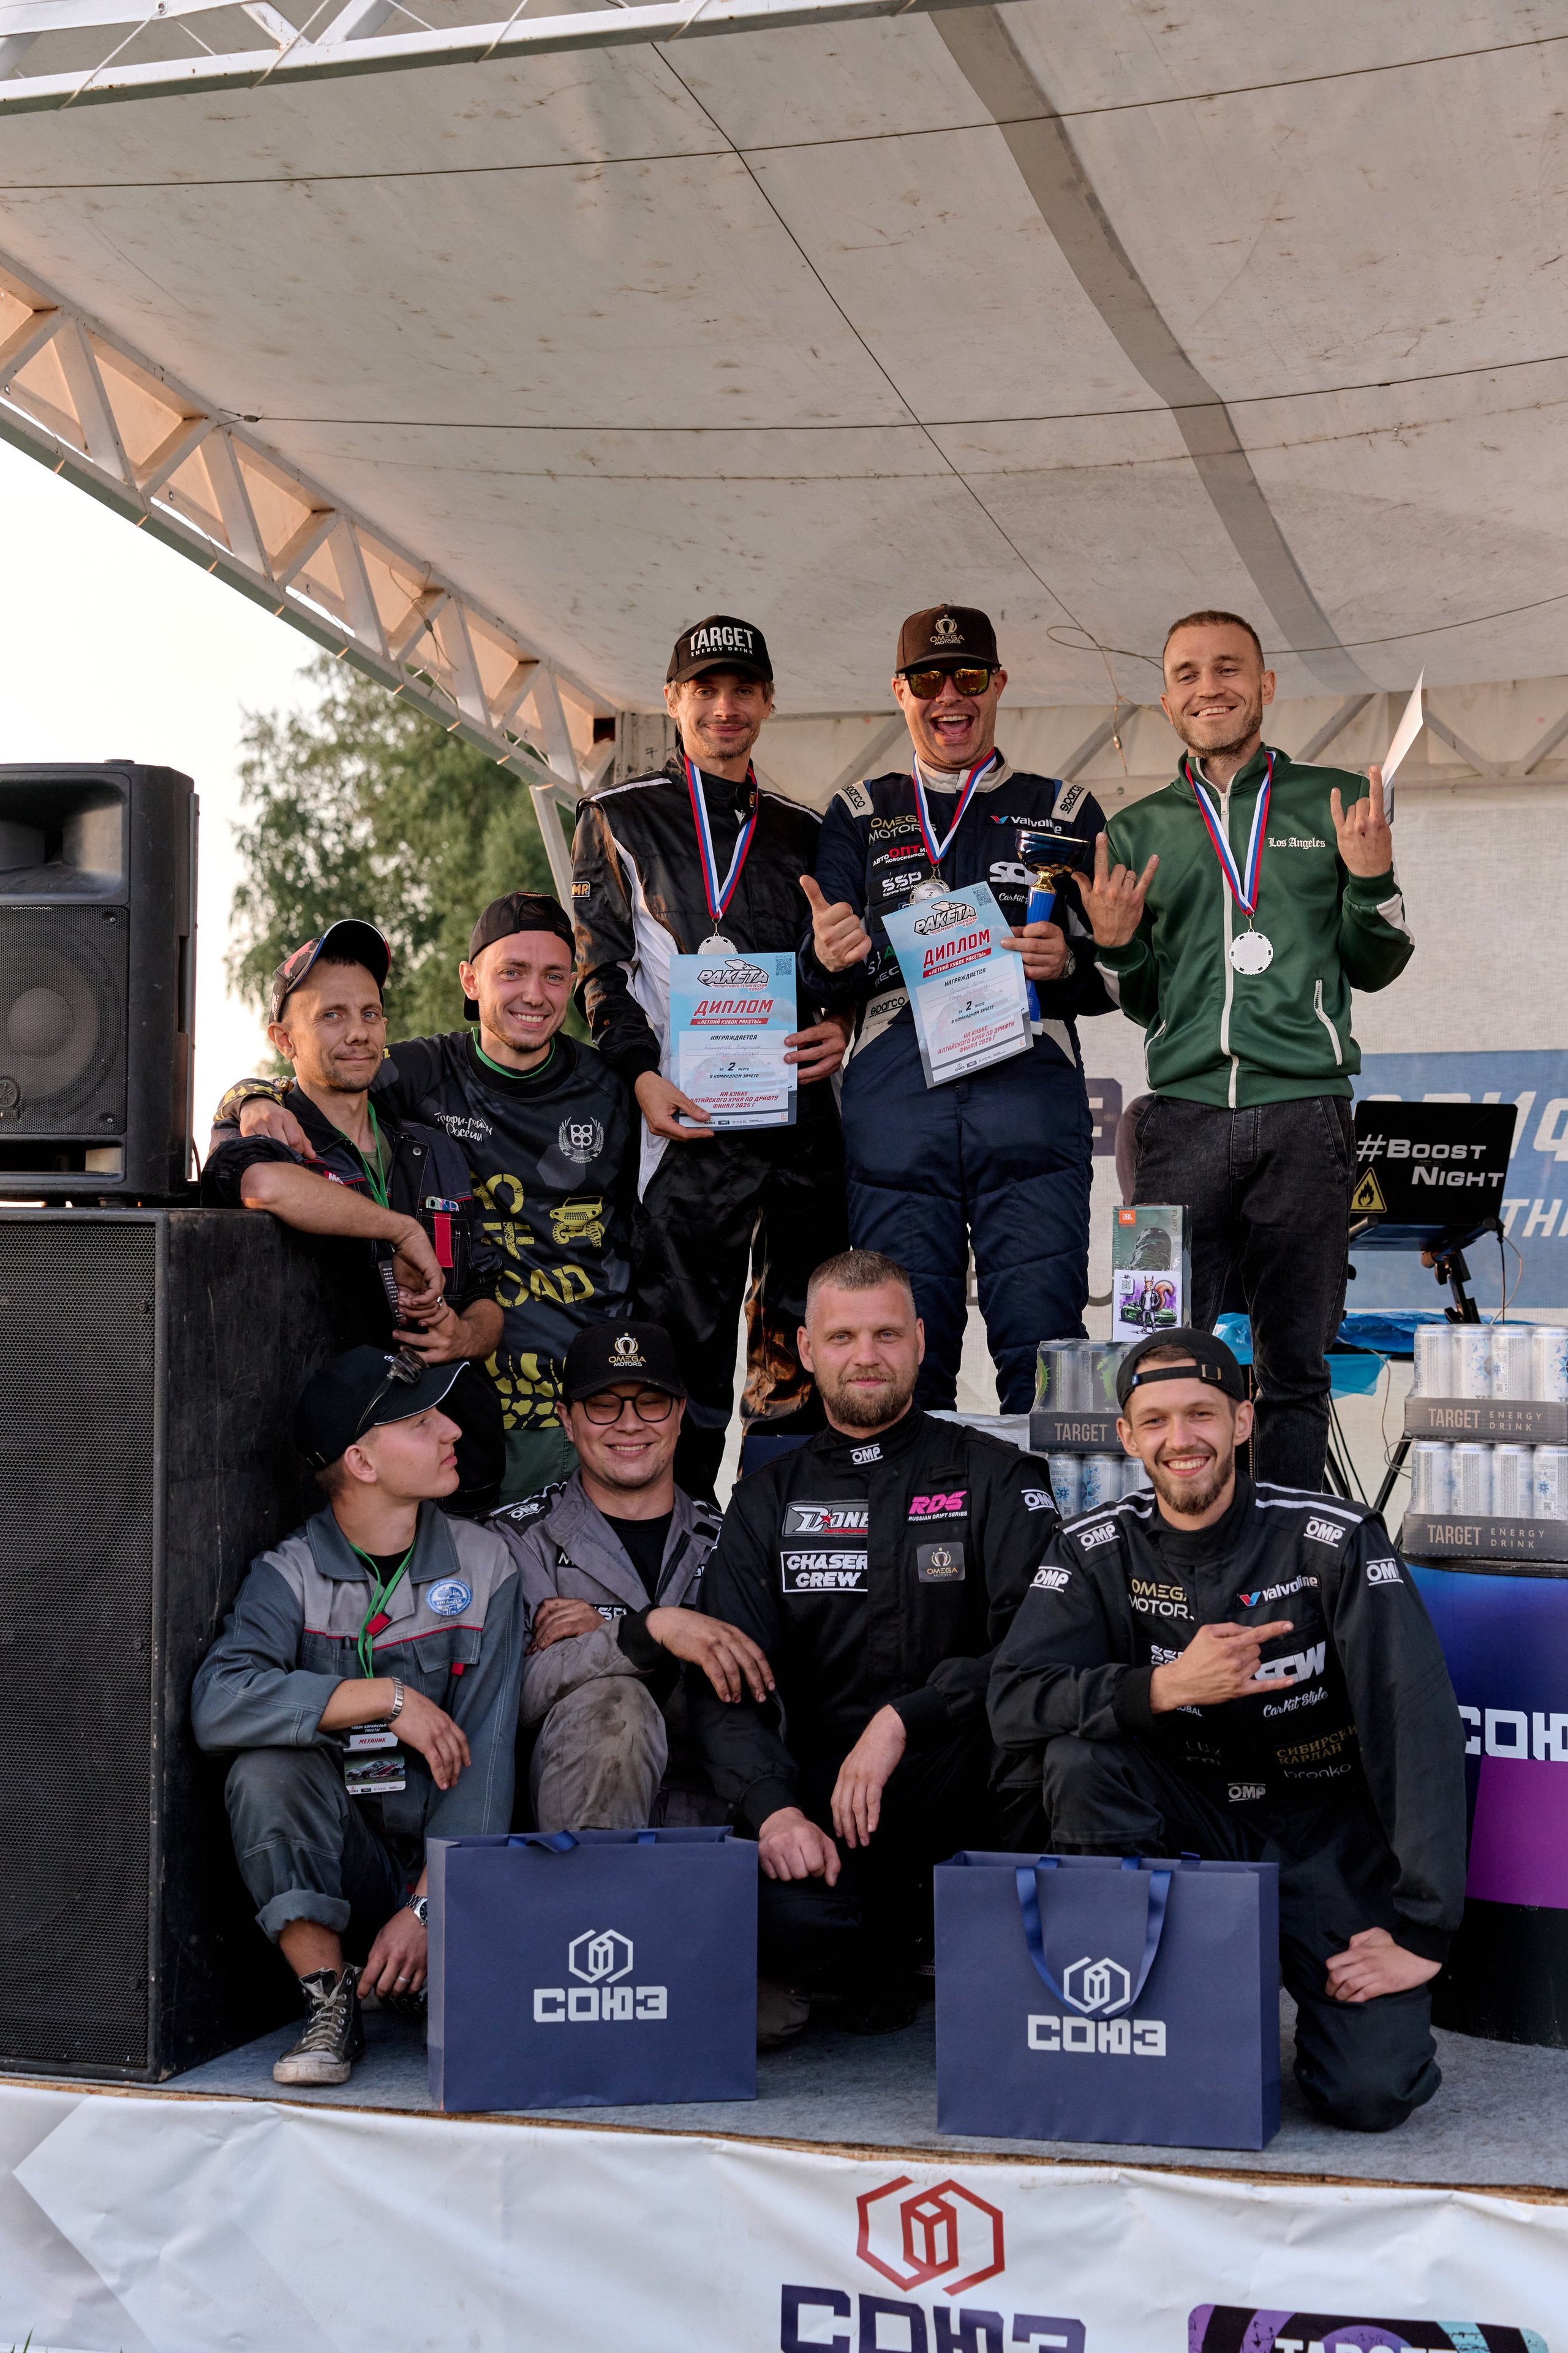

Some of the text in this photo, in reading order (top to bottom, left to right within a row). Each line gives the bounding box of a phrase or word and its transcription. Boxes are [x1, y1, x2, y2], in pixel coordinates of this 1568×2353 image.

[690, 626, 753, 651] TARGET
[691, 646, 753, 657] ENERGY DRINK
[870, 815, 919, 829] OMEG
[1011, 816, 1062, 834] Valvolie
[1267, 837, 1326, 850] Los Angeles
[885, 853, 925, 864] НОВОСИБИРСК
[571, 883, 589, 896] MP
[882, 871, 922, 893] SSP
[914, 904, 976, 934] РАКЕТА
[923, 929, 990, 969] ДИПЛОМ
[949, 959, 965, 969] КУБОК
[698, 969, 769, 986] РАКЕТА
[944, 968, 986, 987] НАГРАЖДАЕТСЯ
[693, 999, 774, 1017] ДИПЛОМ
[870, 996, 905, 1016] sparco
[955, 1011, 979, 1022] КОМАНДНОМ
[980, 1005, 995, 1014] ЗАЧЕТЕ
[965, 1001, 973, 1011] 2
[938, 1039, 971, 1054] АЛТАЙСКОГО
[971, 1034, 986, 1043] КРАЯ
[994, 1021, 1015, 1034] ДРИФТУ
[971, 1025, 988, 1036] КУБКЕ
[959, 1043, 978, 1053] ФИНАЛ
[979, 1037, 992, 1046] 2025
[727, 1062, 736, 1071] 2
[445, 1122, 483, 1141] России
[495, 1264, 595, 1307] OAD
[1428, 1408, 1542, 1429] TARGET ENERGY
[1490, 1422, 1532, 1431] DRINK
[1054, 1422, 1108, 1442] TARGET
[851, 1446, 881, 1463] OMP
[510, 1503, 539, 1519] OMP
[908, 1490, 968, 1514] RDS
[1080, 1524, 1116, 1547] OMP
[1306, 1520, 1343, 1542] OMP
[1427, 1525, 1545, 1546] TARGET ENERGY
[1491, 1539, 1535, 1548] DRINK
[786, 1554, 868, 1571] CHASER
[796, 1571, 862, 1588] CREW
[1033, 1569, 1069, 1587] OMP
[1131, 1579, 1187, 1602] OMEG
[1262, 1575, 1318, 1601] Valvoline
[1128, 1593, 1194, 1620] MOTOR
[1302, 1686, 1328, 1706] Style
[1276, 1724, 1358, 1758] СИБИРСКИ
[1457, 1705, 1568, 1762] СОЮ
[1278, 1742, 1343, 1765] КАРДАН
[1284, 1764, 1351, 1779] bronko
[1228, 1785, 1266, 1799] OMP
[533, 1985, 668, 2022] СОЮЗ
[1027, 2014, 1166, 2057] СОЮЗ
[780, 2284, 1087, 2353] СОЮЗ
